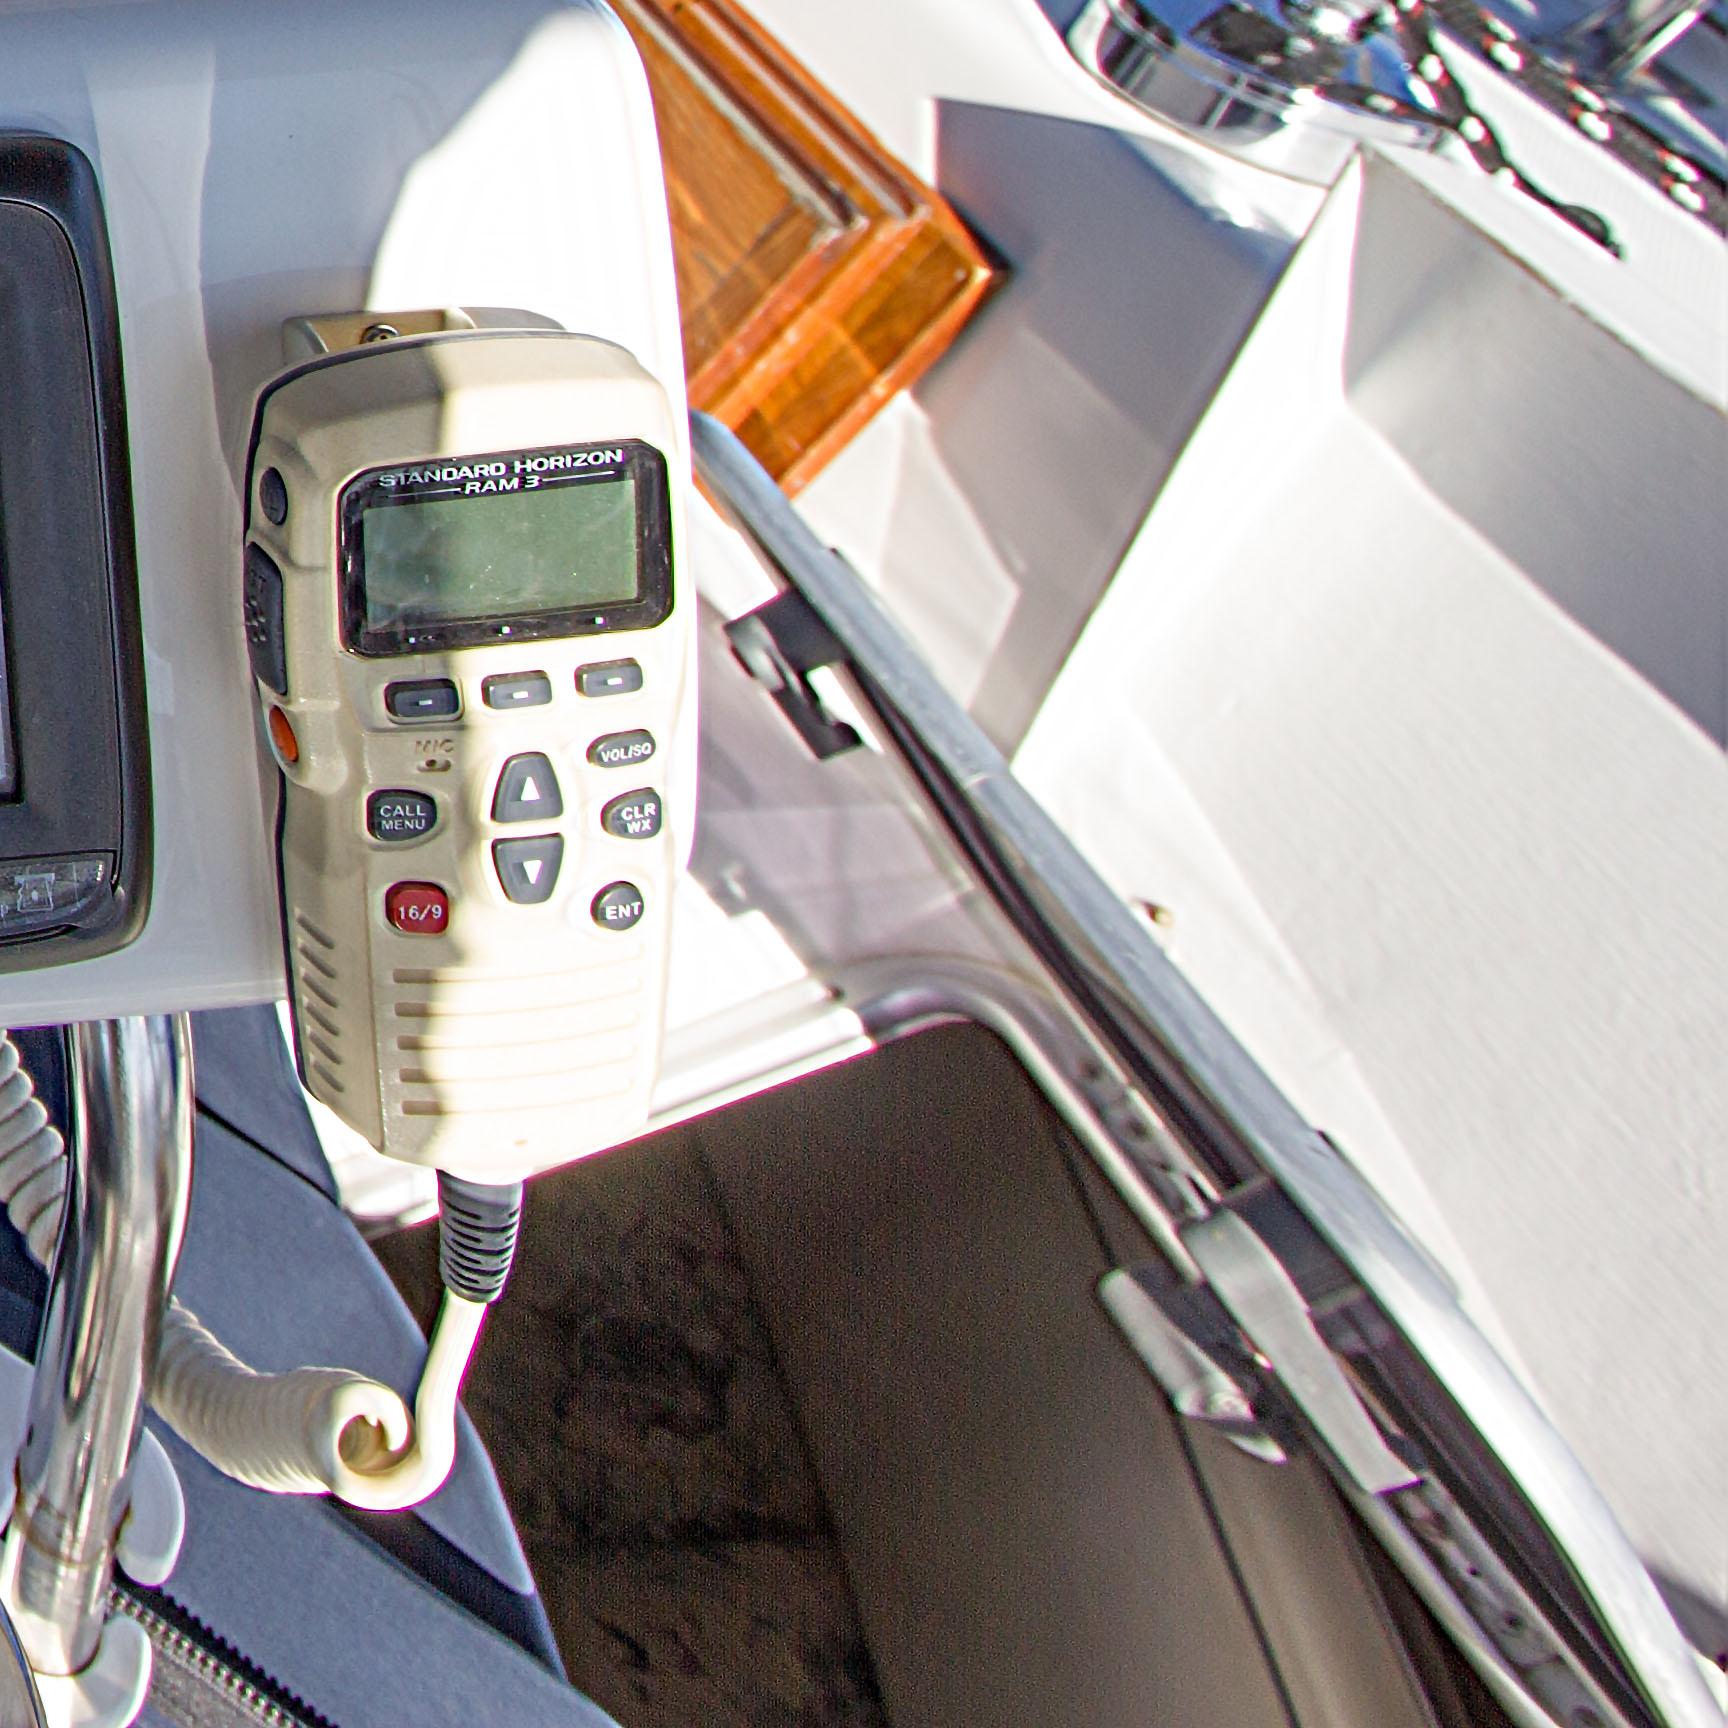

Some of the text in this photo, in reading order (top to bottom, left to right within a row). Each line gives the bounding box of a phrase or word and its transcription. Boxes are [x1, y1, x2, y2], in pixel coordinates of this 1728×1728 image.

[378, 447, 624, 488] STANDARD HORIZON
[463, 474, 543, 496] RAM 3
[600, 741, 653, 763] VOL/SQ
[379, 804, 427, 818] CALL
[620, 801, 657, 822] CLR
[380, 818, 426, 831] MENU
[625, 818, 653, 834] WX
[397, 903, 443, 921] 16/9
[604, 901, 642, 920] ENT
